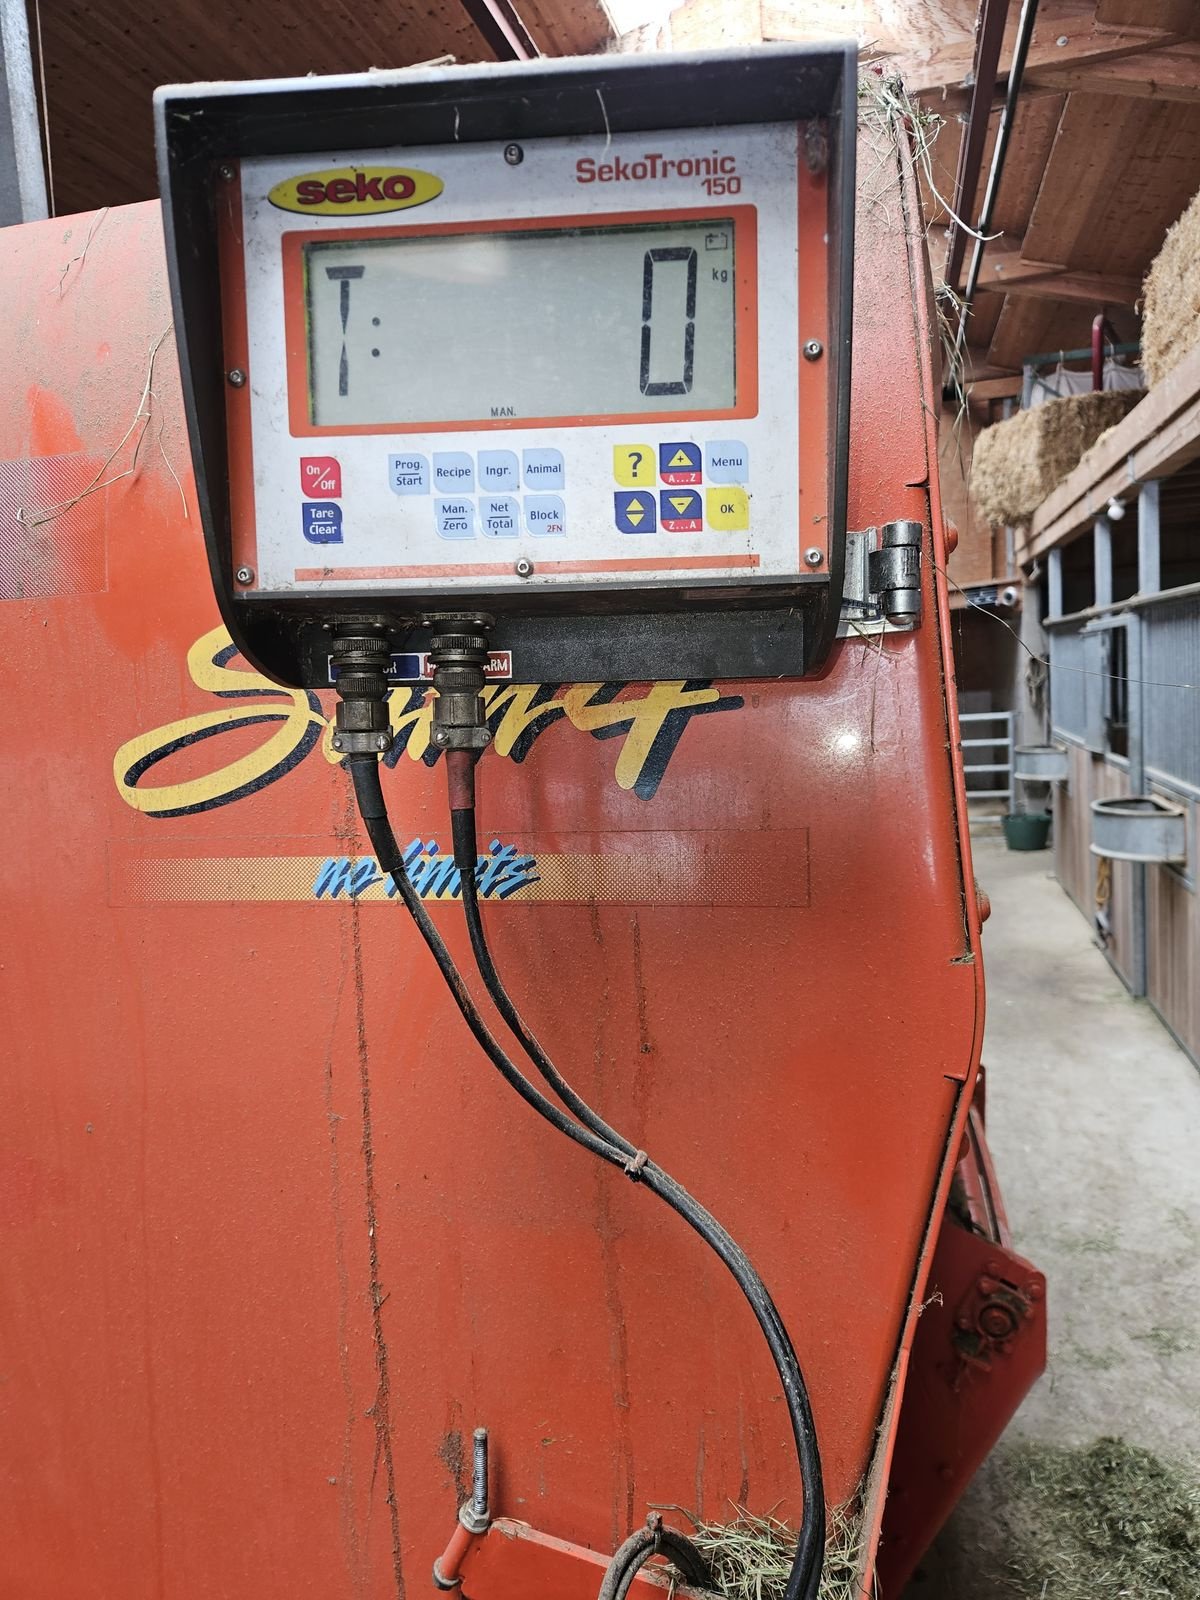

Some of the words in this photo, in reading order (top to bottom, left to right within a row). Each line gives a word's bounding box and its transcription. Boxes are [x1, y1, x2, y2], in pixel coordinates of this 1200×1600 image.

[576, 150, 737, 183] SekoTronic
[296, 173, 416, 205] seko
[701, 176, 741, 196] 150
[712, 268, 729, 283] kg
[640, 246, 698, 396] 0
[490, 406, 517, 417] MAN.
[395, 460, 423, 471] Prog.
[711, 458, 742, 467] Menu
[436, 467, 471, 479] Recipe
[486, 466, 511, 477] Ingr.
[526, 464, 562, 474] Animal
[396, 476, 423, 487] Start
[310, 508, 335, 519] Tare
[442, 504, 468, 514] Man.
[490, 503, 509, 513] Net
[720, 504, 735, 514] OK
[530, 510, 559, 521] Block
[309, 523, 338, 535] Clear
[442, 521, 468, 531] Zero
[487, 519, 513, 530] Total
[547, 524, 563, 533] 2FN
[312, 855, 384, 899] no
